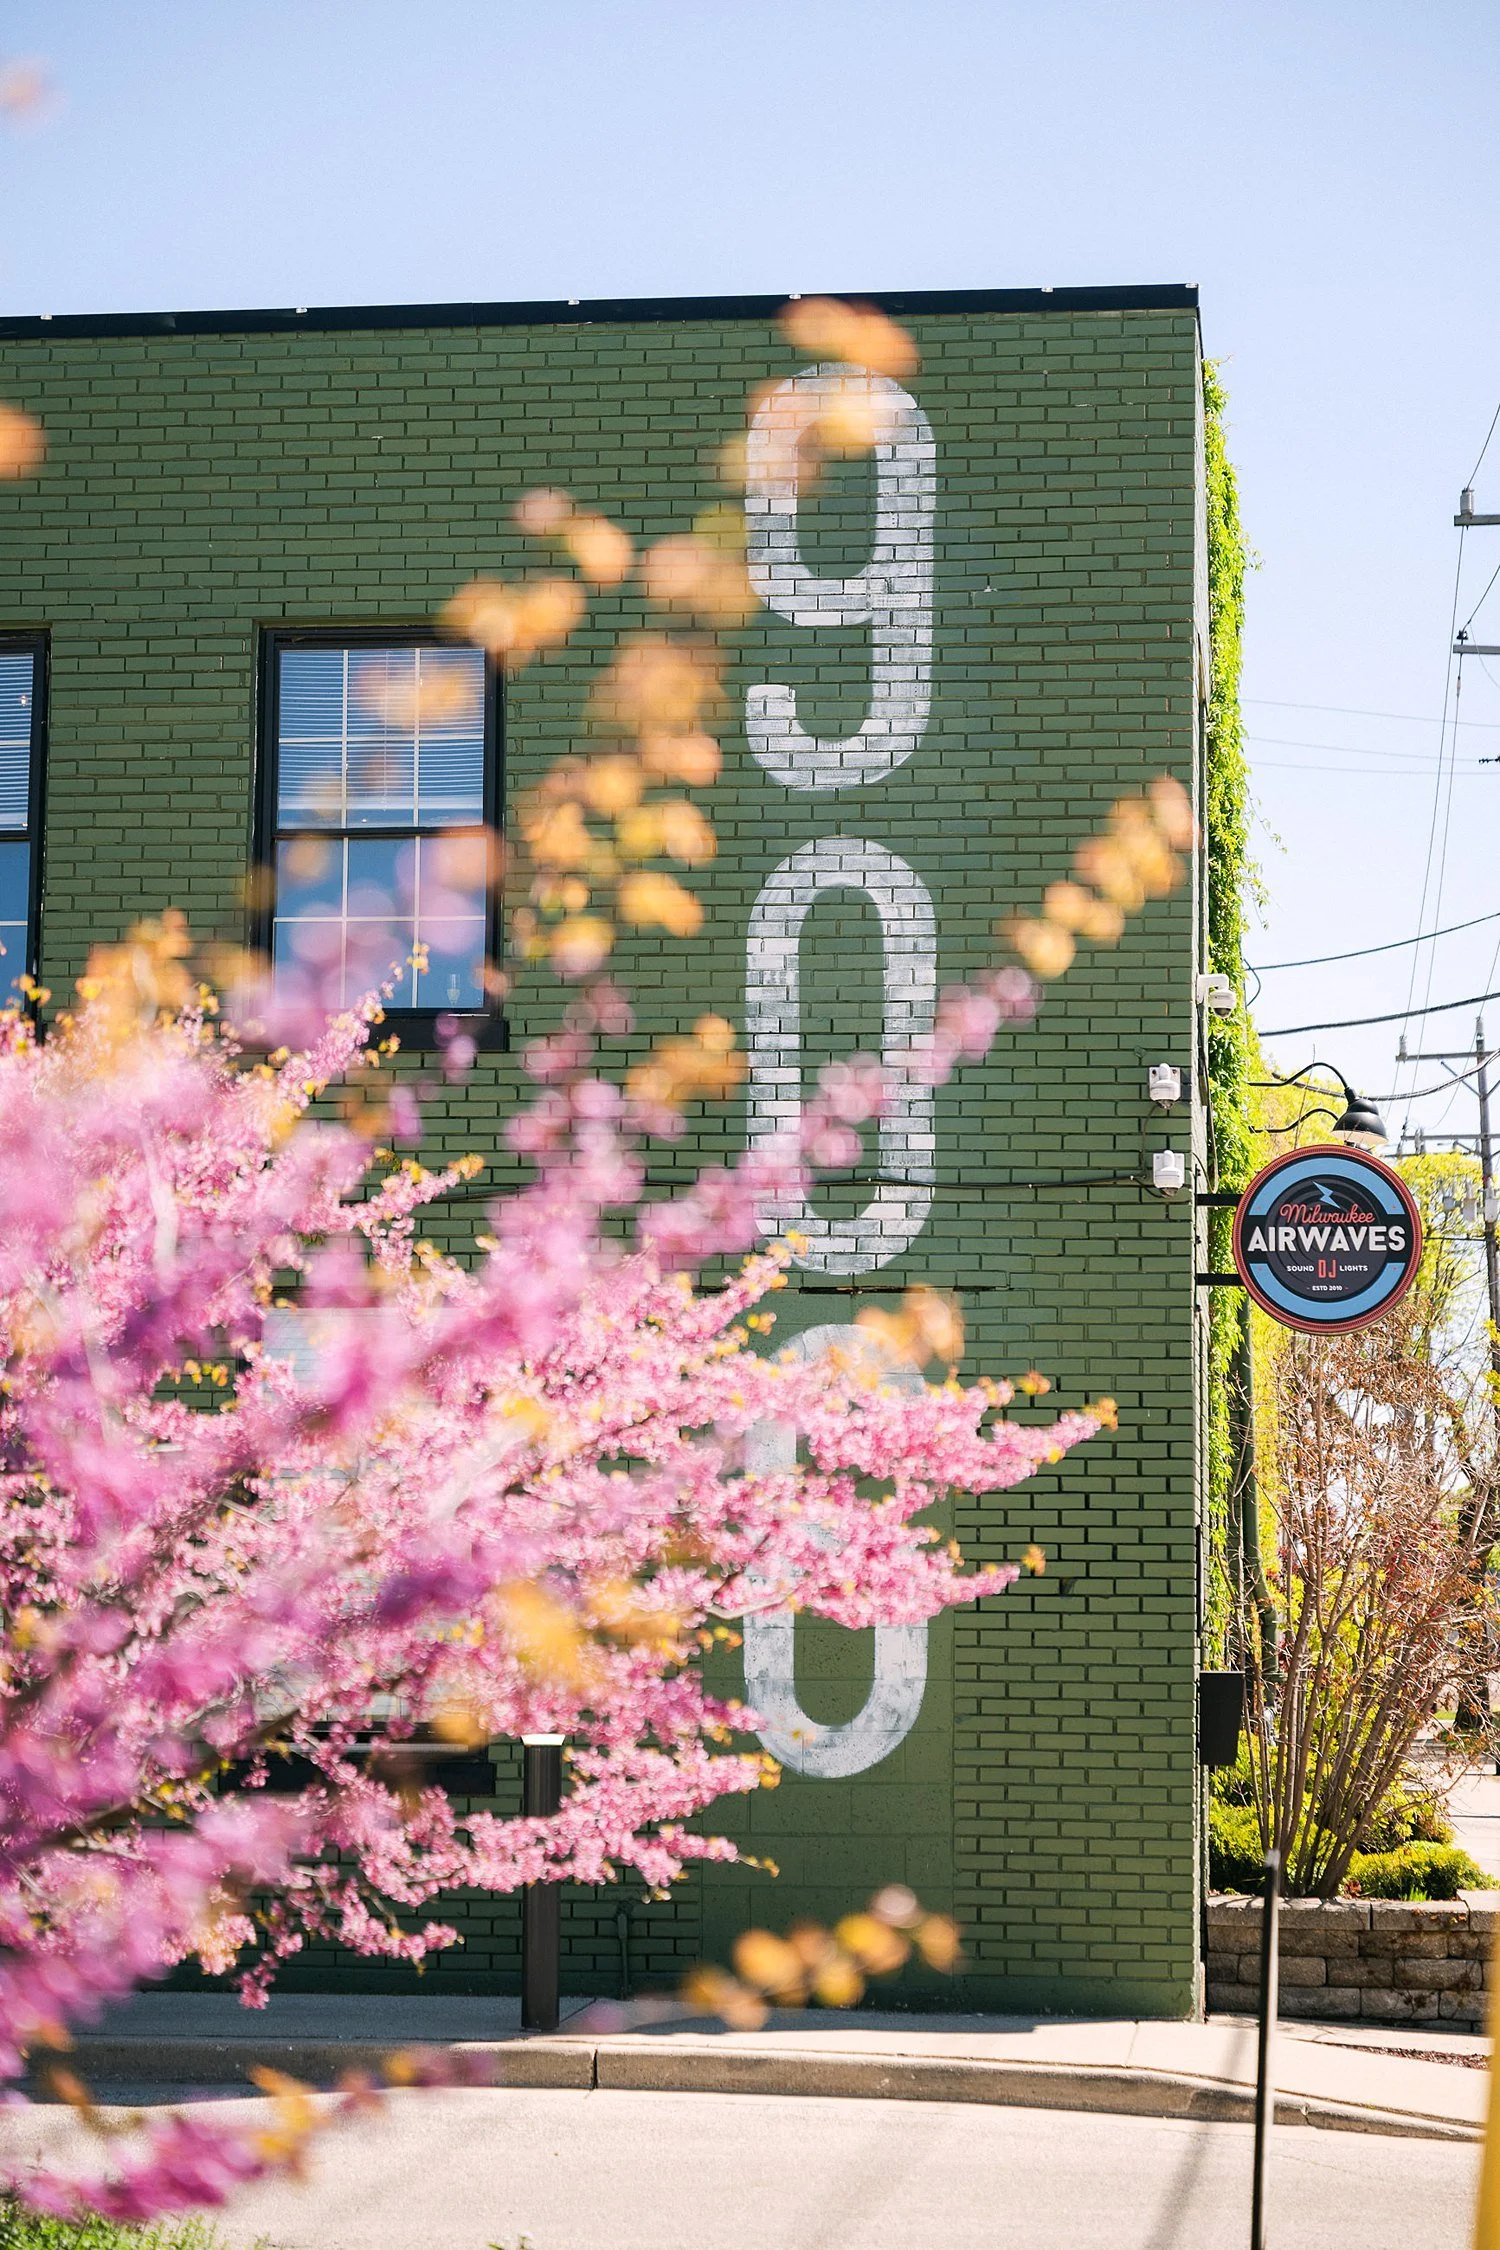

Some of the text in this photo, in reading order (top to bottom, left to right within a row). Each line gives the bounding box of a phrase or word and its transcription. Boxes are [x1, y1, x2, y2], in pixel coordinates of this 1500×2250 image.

[1280, 1203, 1375, 1224] Milwaukee
[1248, 1225, 1406, 1252] AIRWAVES
[1318, 1259, 1336, 1279] DJ
